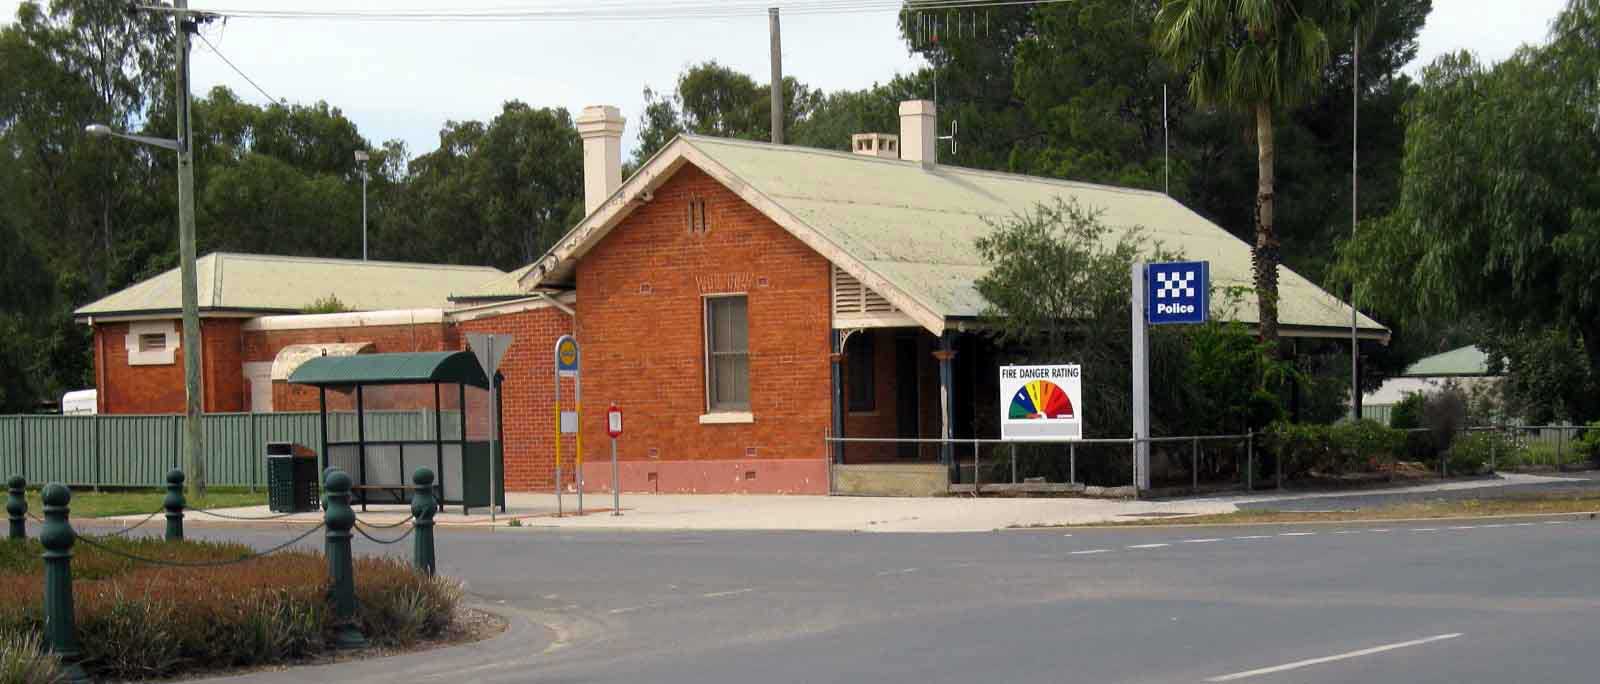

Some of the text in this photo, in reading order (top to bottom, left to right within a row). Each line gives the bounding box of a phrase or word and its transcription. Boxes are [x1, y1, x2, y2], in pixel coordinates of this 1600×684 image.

[1157, 303, 1194, 314] Police
[1002, 367, 1079, 378] FIRE DANGER RATING
